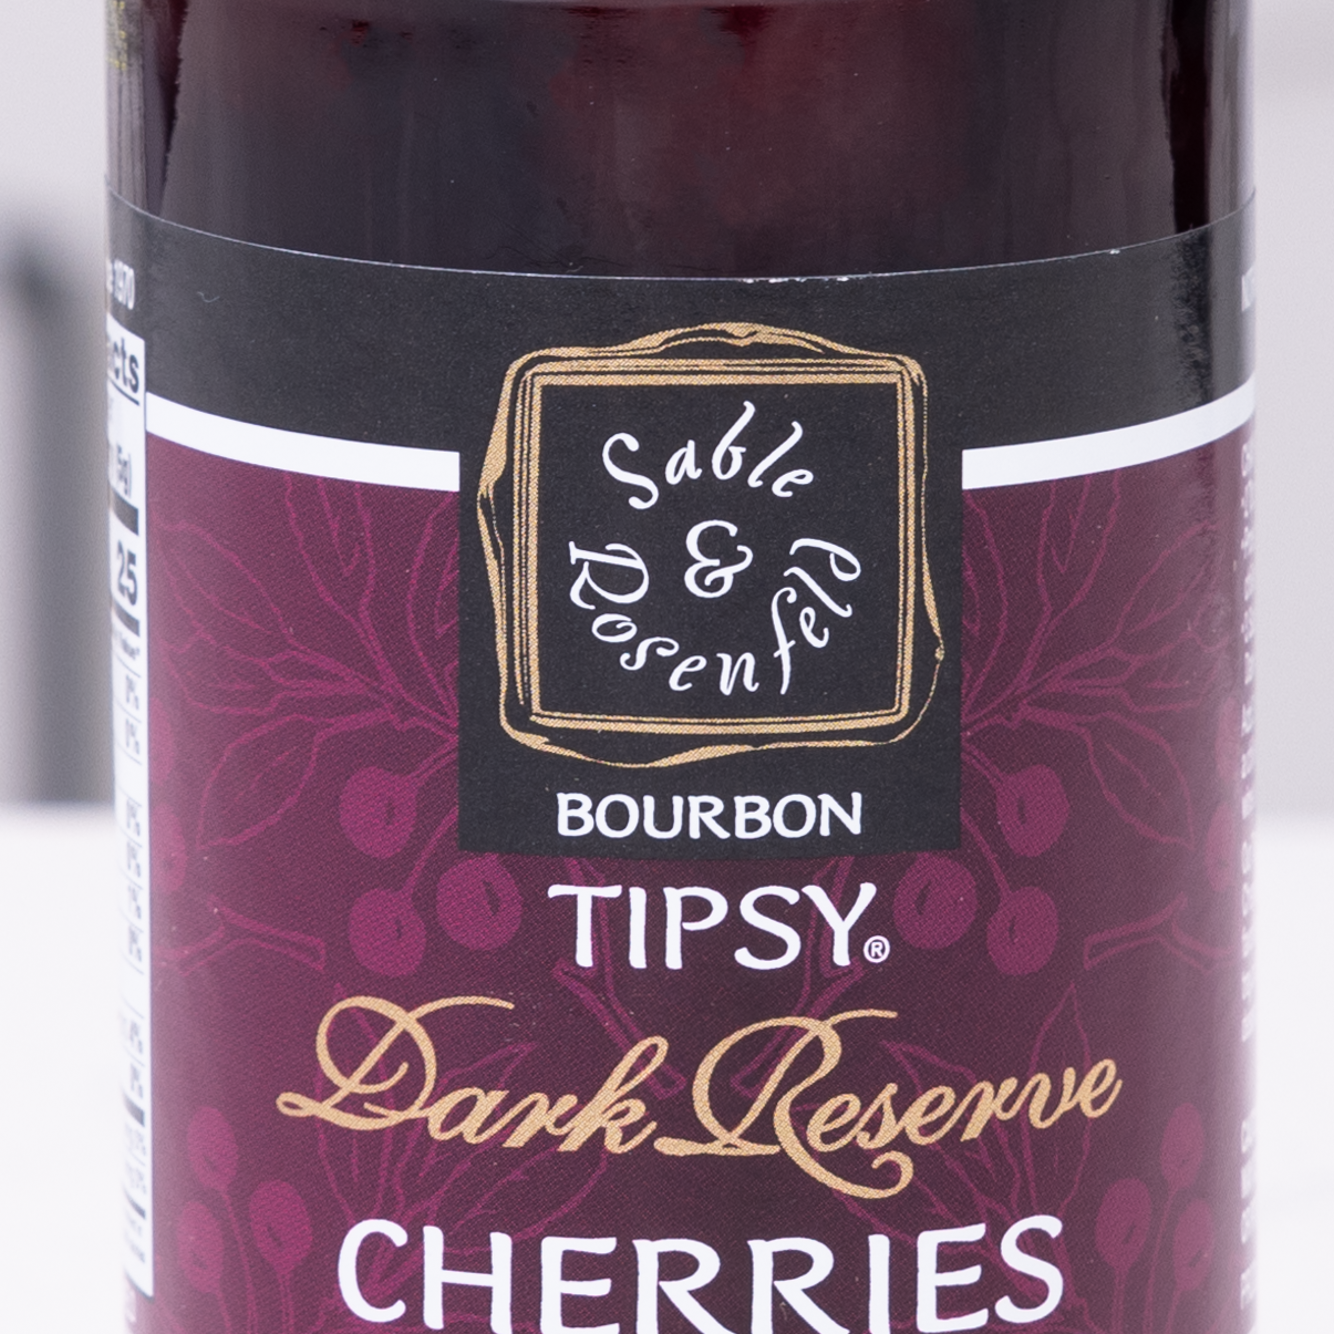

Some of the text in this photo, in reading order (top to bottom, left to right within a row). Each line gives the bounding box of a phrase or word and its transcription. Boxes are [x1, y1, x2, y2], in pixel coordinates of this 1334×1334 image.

[601, 400, 814, 510] Sable
[116, 540, 138, 605] 25
[683, 519, 754, 599] &
[568, 536, 862, 696] Rosenfeld
[556, 791, 863, 840] BOURBON
[275, 995, 1123, 1200] Dark Reserve
